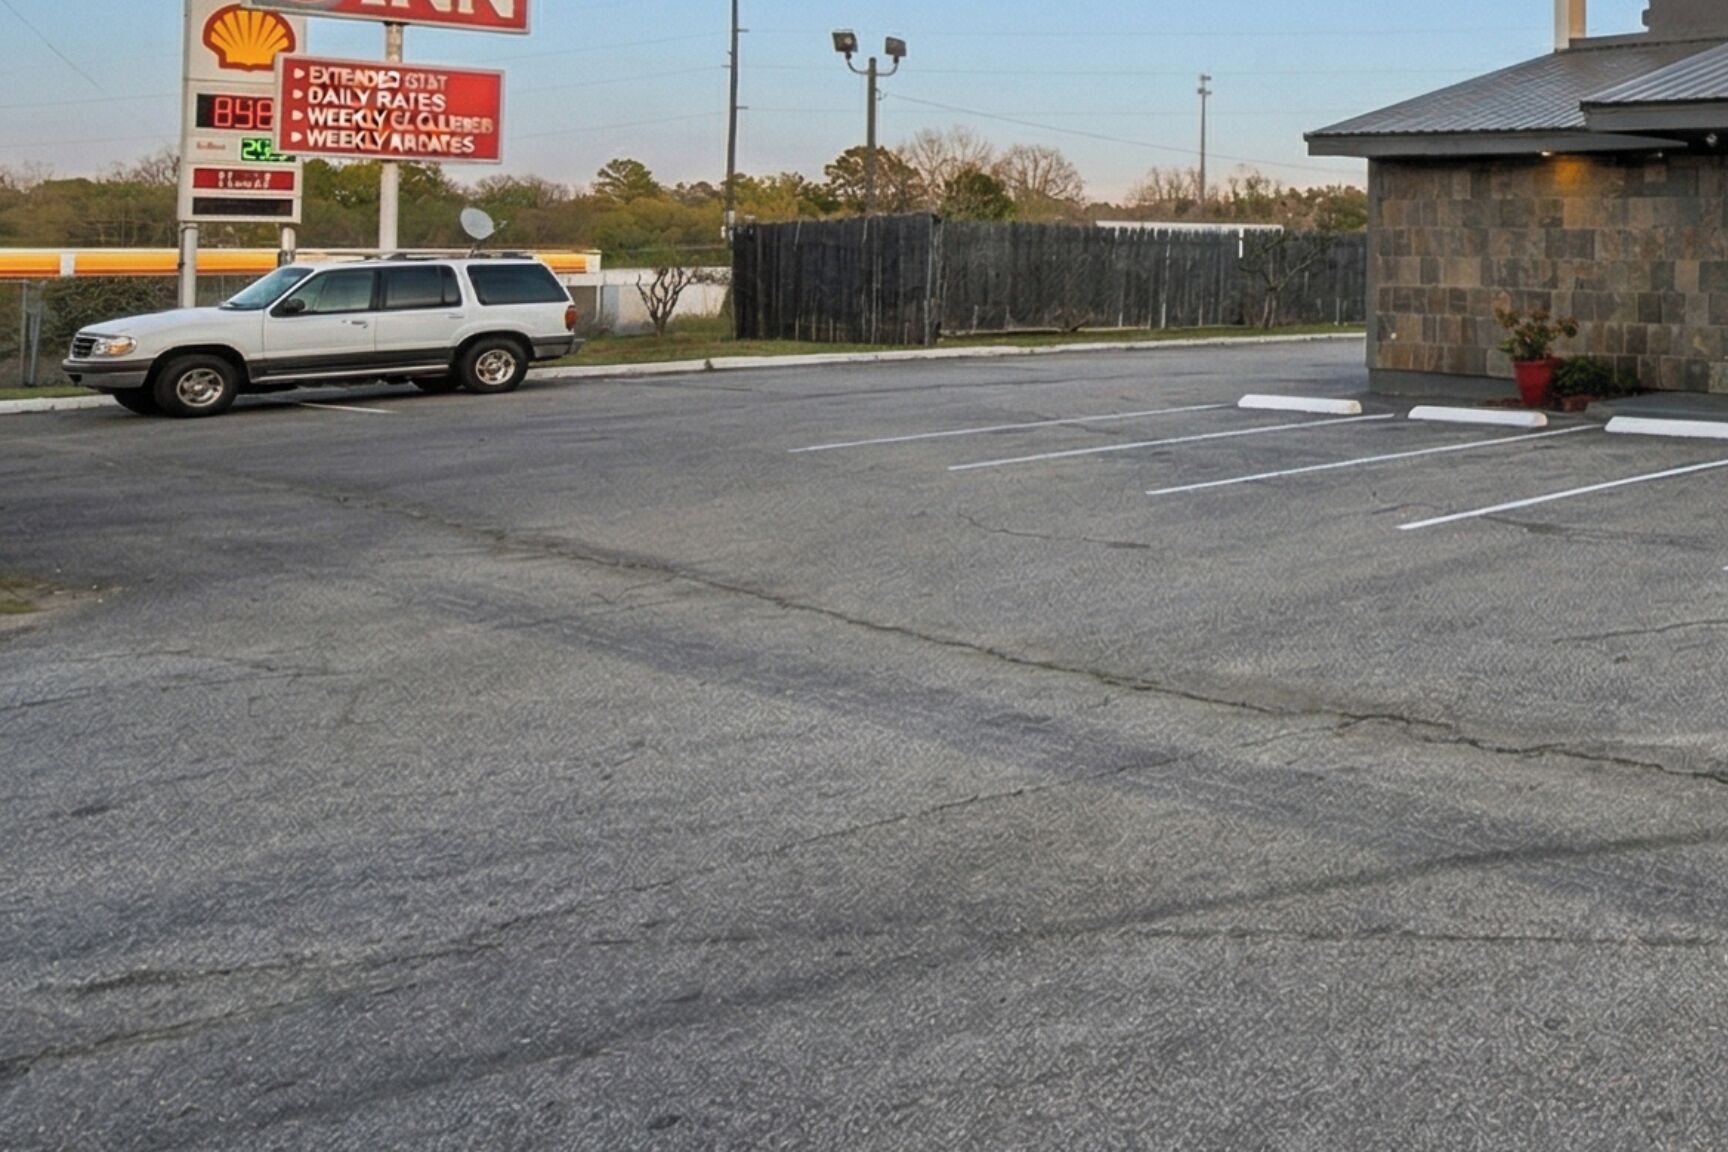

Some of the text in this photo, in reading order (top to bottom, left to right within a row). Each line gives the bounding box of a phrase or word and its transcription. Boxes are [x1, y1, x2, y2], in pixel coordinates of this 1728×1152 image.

[307, 86, 446, 113] DAILY RATES
[306, 106, 387, 131] WEEKLY
[306, 128, 389, 151] WEEKLY
